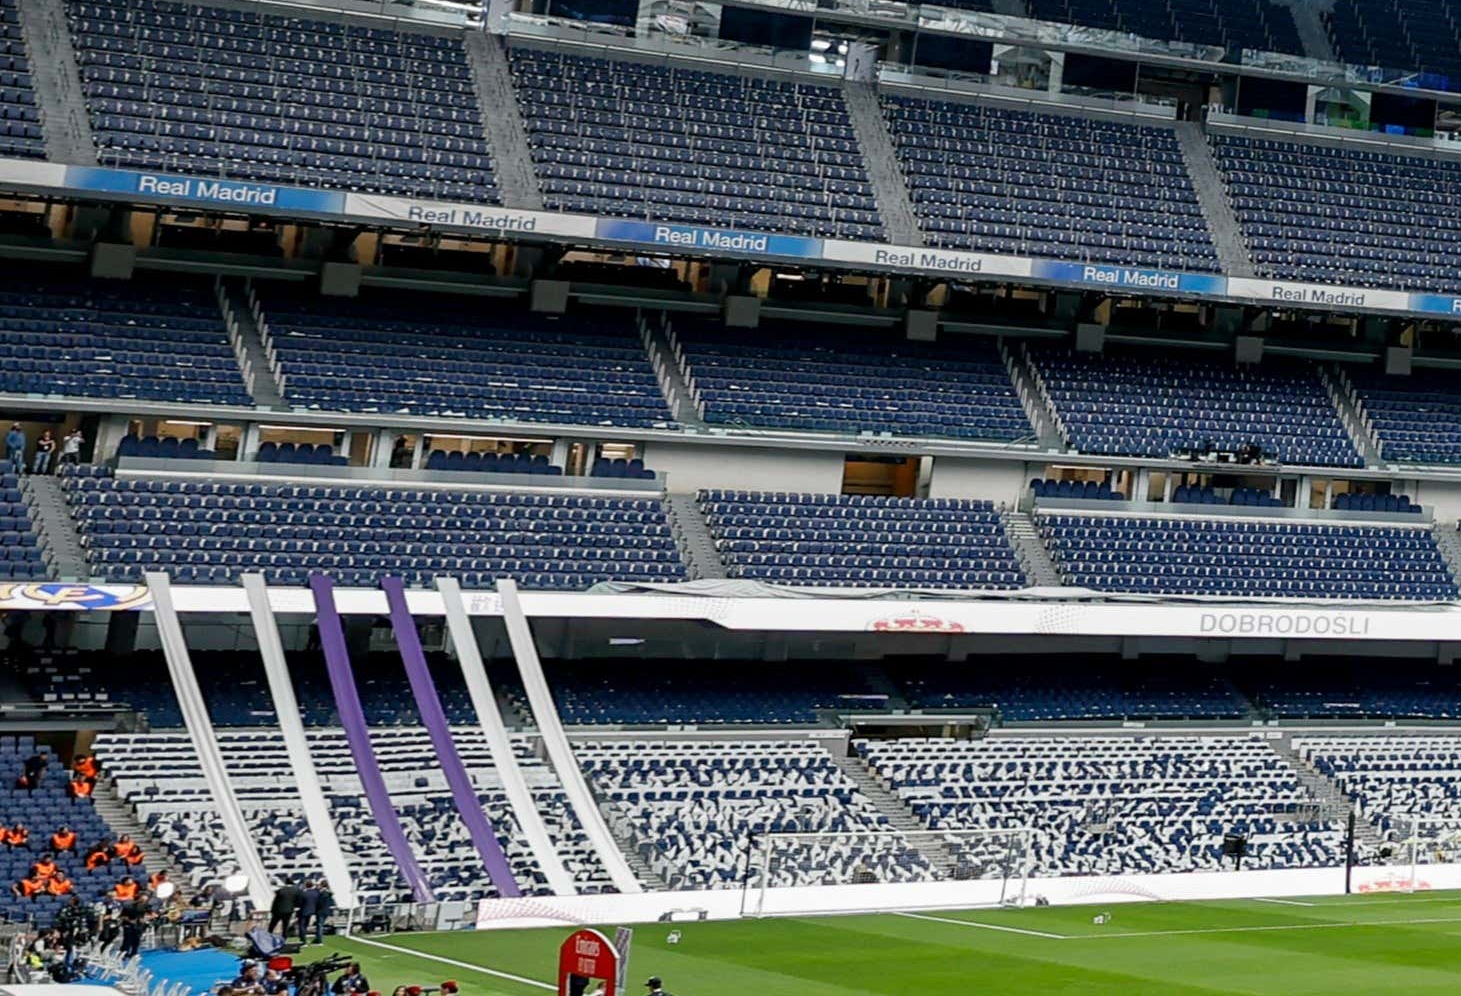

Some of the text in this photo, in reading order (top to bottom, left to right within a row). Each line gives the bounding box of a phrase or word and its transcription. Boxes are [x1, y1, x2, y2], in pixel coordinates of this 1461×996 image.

[139, 175, 276, 205] Real Madrid
[408, 205, 536, 232] Real Madrid
[655, 225, 767, 252] Real Madrid
[875, 248, 981, 273] Real Madrid
[1084, 265, 1179, 290] Real Madrid
[1272, 284, 1365, 306] Real Madrid
